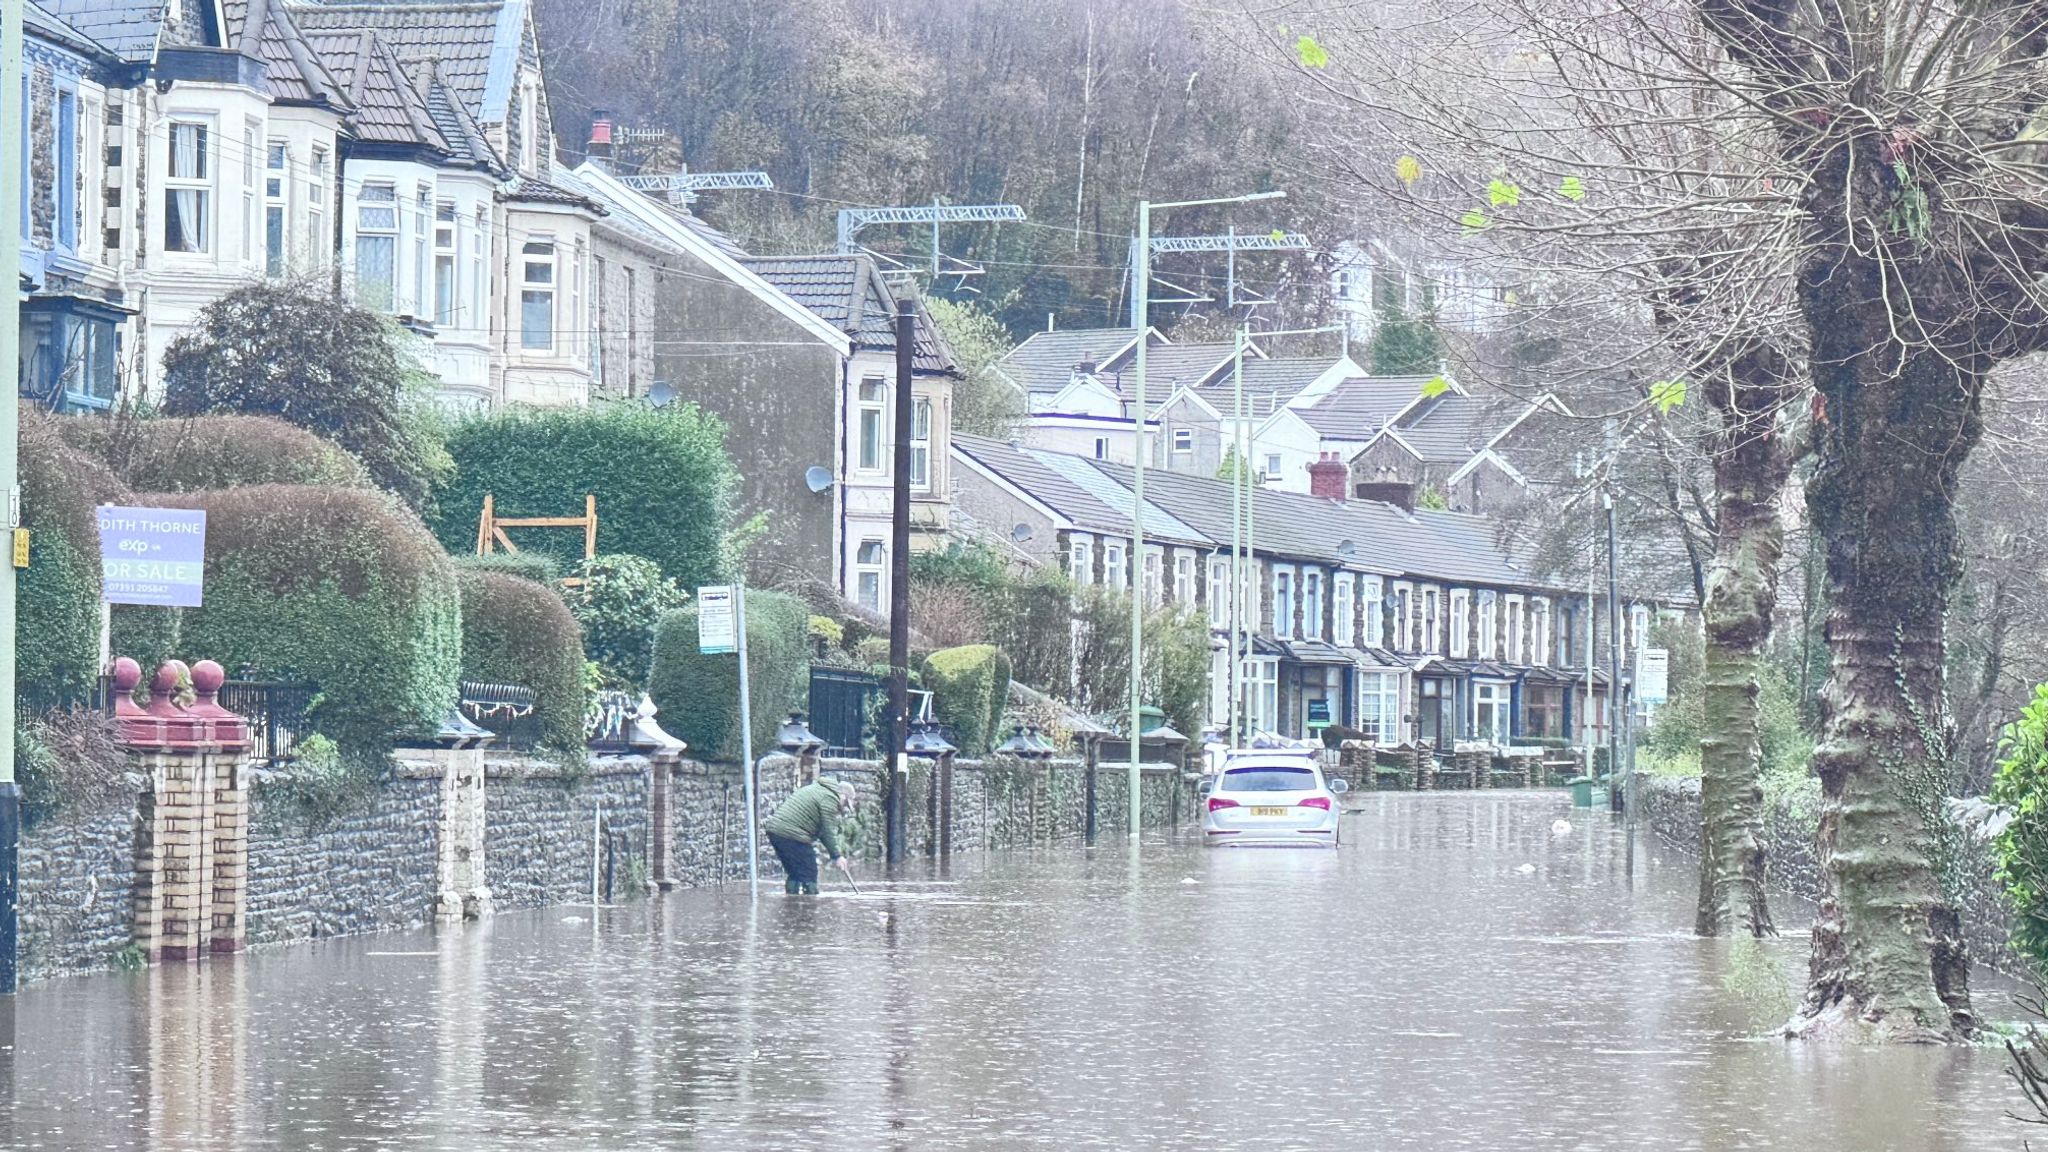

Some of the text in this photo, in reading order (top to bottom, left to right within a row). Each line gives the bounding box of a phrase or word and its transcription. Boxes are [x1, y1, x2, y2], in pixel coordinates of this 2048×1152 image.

[98, 519, 201, 535] DITH THORNE
[103, 562, 188, 581] OR SALE
